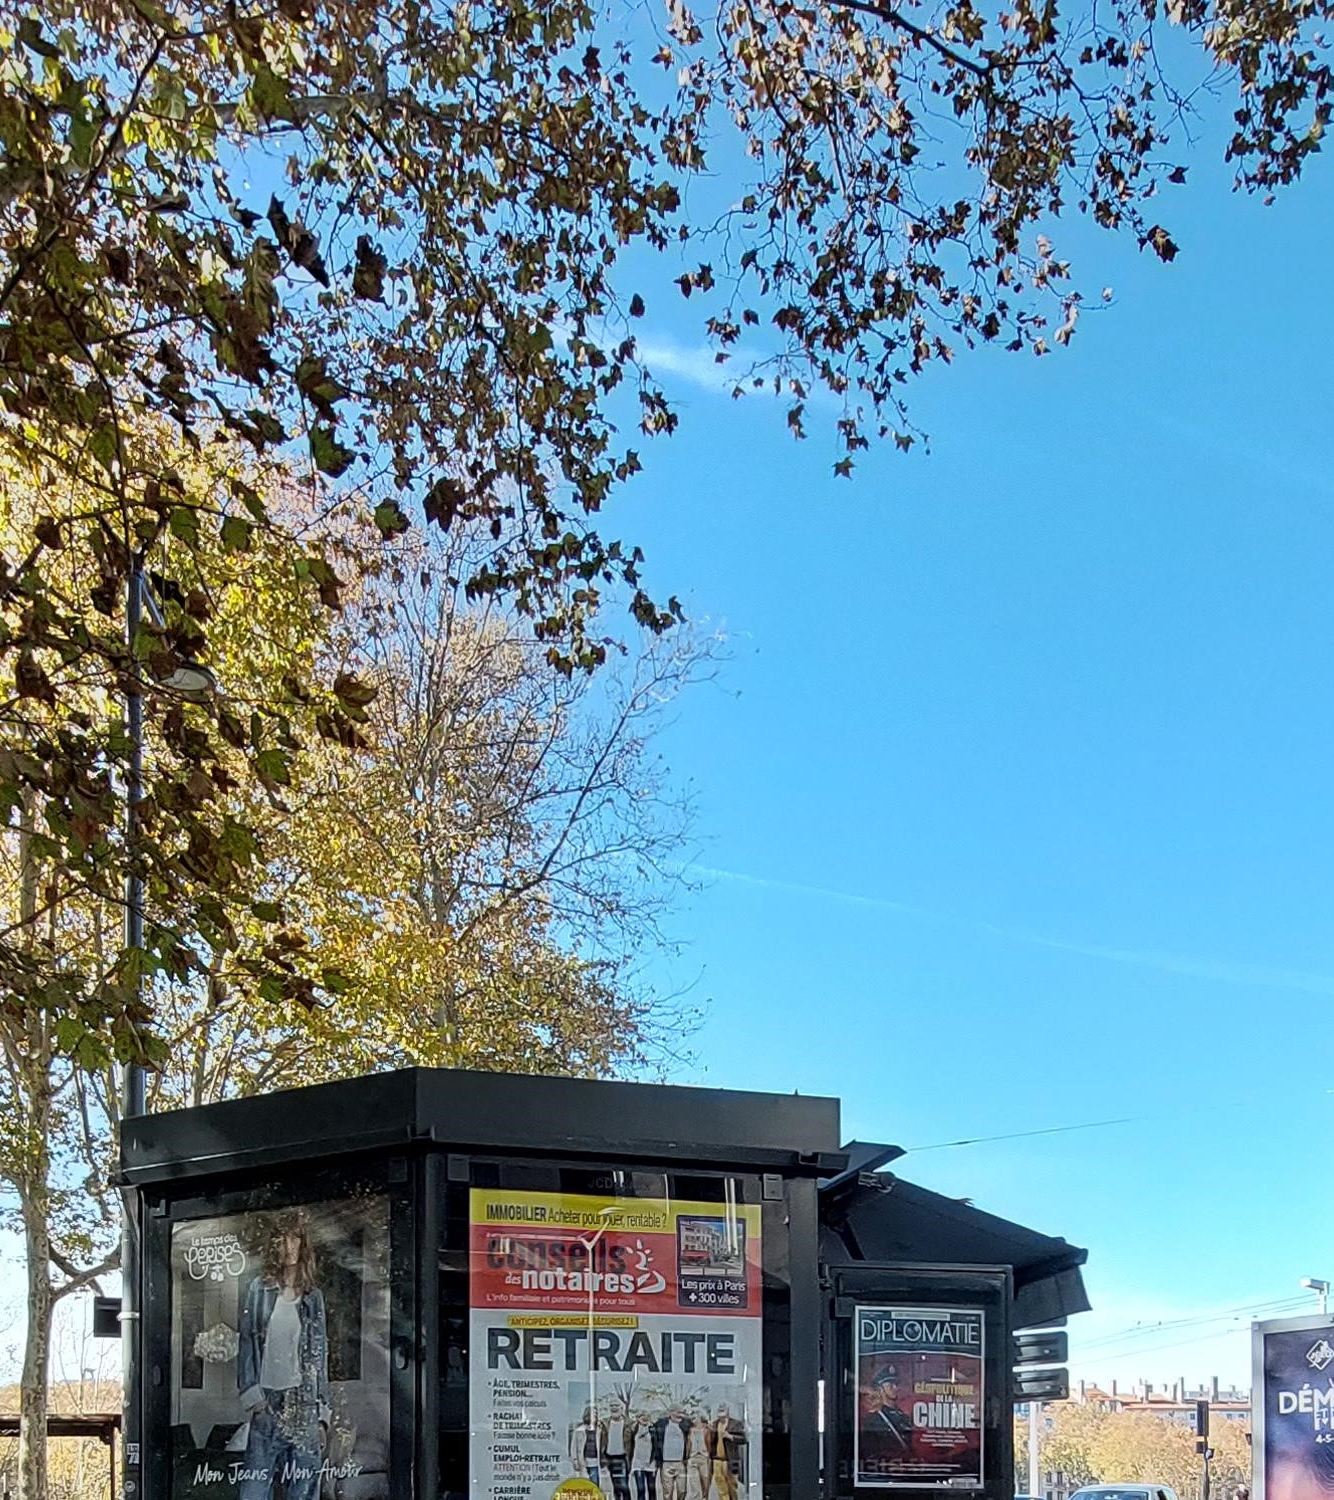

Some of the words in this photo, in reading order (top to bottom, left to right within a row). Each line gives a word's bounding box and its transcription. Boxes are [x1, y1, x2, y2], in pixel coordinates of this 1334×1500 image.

[486, 1204, 547, 1221] IMMOBILIER
[548, 1207, 581, 1224] Acheter
[627, 1212, 661, 1228] rentable
[661, 1213, 667, 1227] ?
[505, 1271, 521, 1284] des
[522, 1267, 635, 1293] notaires
[681, 1279, 697, 1290] Les
[699, 1279, 716, 1292] prix
[717, 1280, 723, 1291] à
[724, 1280, 746, 1292] Paris
[698, 1292, 716, 1303] 300
[717, 1292, 740, 1304] villes
[861, 1319, 980, 1345] DIPLOMATIE
[487, 1328, 735, 1375] RETRAITE
[913, 1401, 976, 1429] CHINE
[493, 1445, 520, 1453] CUMUL
[493, 1454, 561, 1462] EMPLOI-RETRAITE
[193, 1461, 224, 1486] Mon
[280, 1459, 313, 1484] Mon
[315, 1457, 364, 1485] Amour
[493, 1485, 532, 1494] CARRIÈRE
